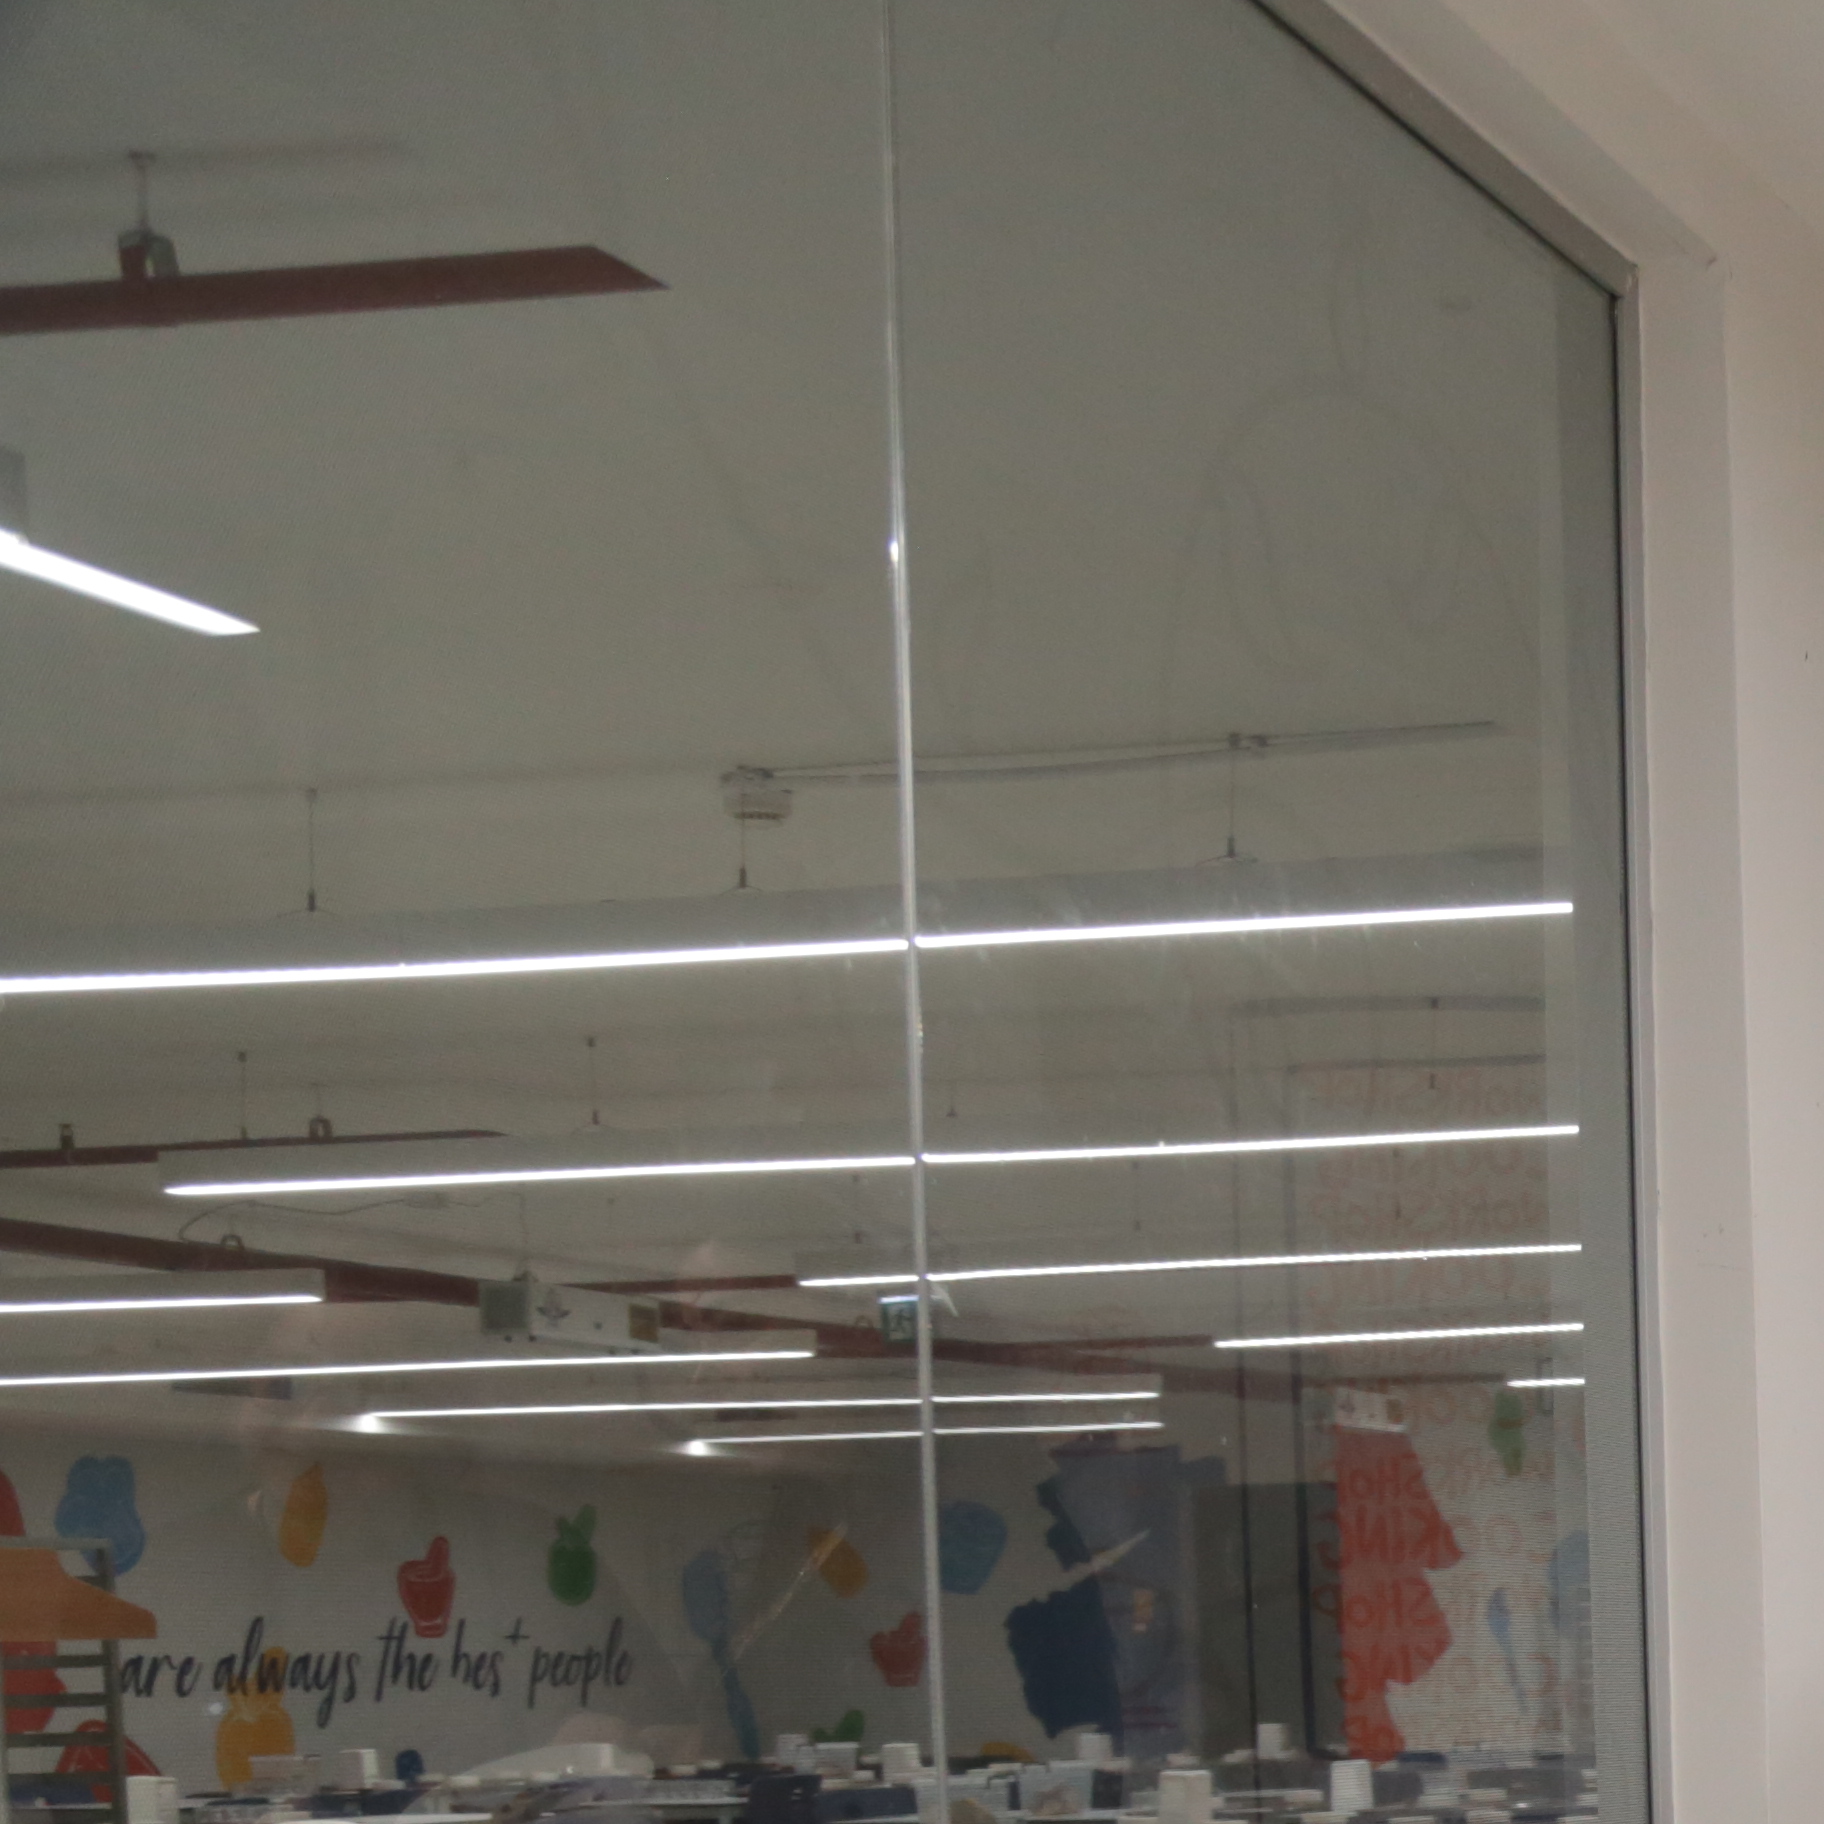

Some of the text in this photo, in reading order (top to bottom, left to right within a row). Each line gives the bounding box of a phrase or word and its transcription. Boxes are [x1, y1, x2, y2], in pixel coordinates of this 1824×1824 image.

[119, 1652, 198, 1699] are
[212, 1615, 362, 1730] always
[375, 1616, 439, 1702] the
[527, 1615, 634, 1710] people
